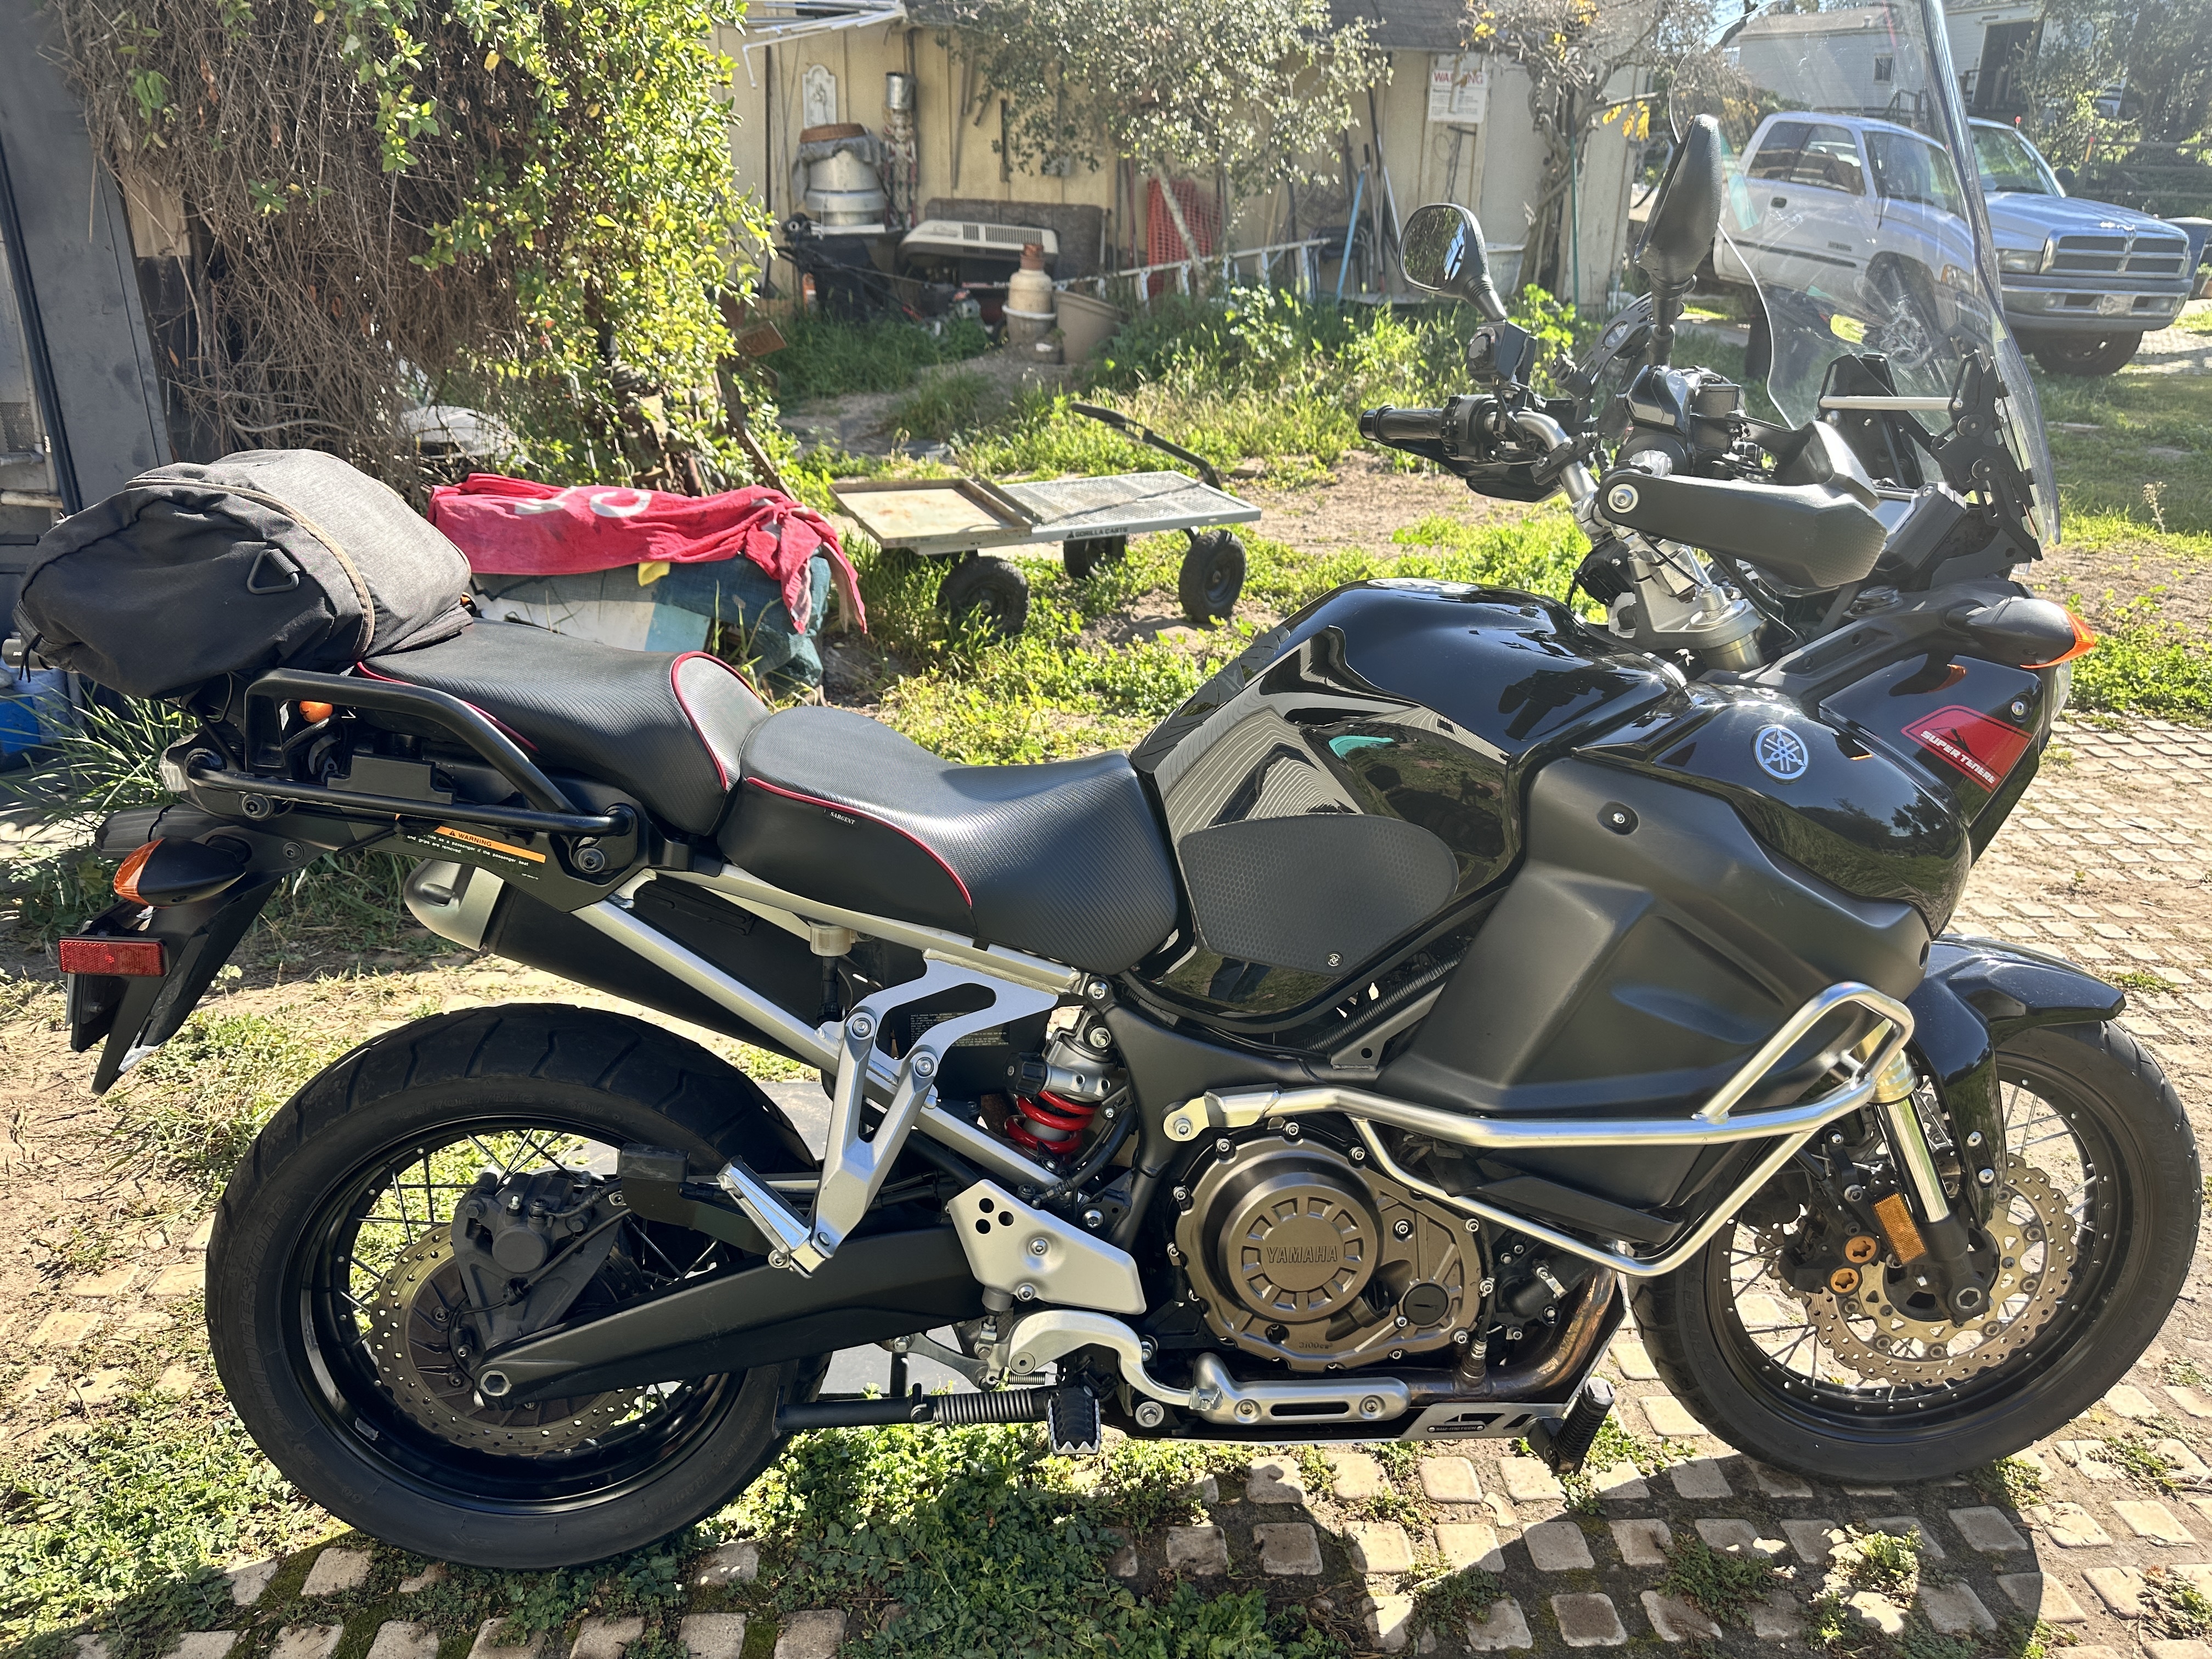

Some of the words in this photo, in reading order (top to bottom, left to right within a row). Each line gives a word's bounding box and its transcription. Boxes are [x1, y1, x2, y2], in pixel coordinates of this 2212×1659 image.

[1075, 528, 1103, 537] GORILLA
[1105, 526, 1128, 534] CARTS
[1920, 730, 1961, 758] SUPER
[830, 811, 856, 825] SARGENT
[458, 832, 492, 847] WARNING
[452, 841, 475, 851] passenger
[492, 853, 516, 862] passenger
[2155, 1211, 2183, 1274] WING
[1266, 1245, 1338, 1263] YAMAHA
[240, 1190, 295, 1431] BRIDGESTONE
